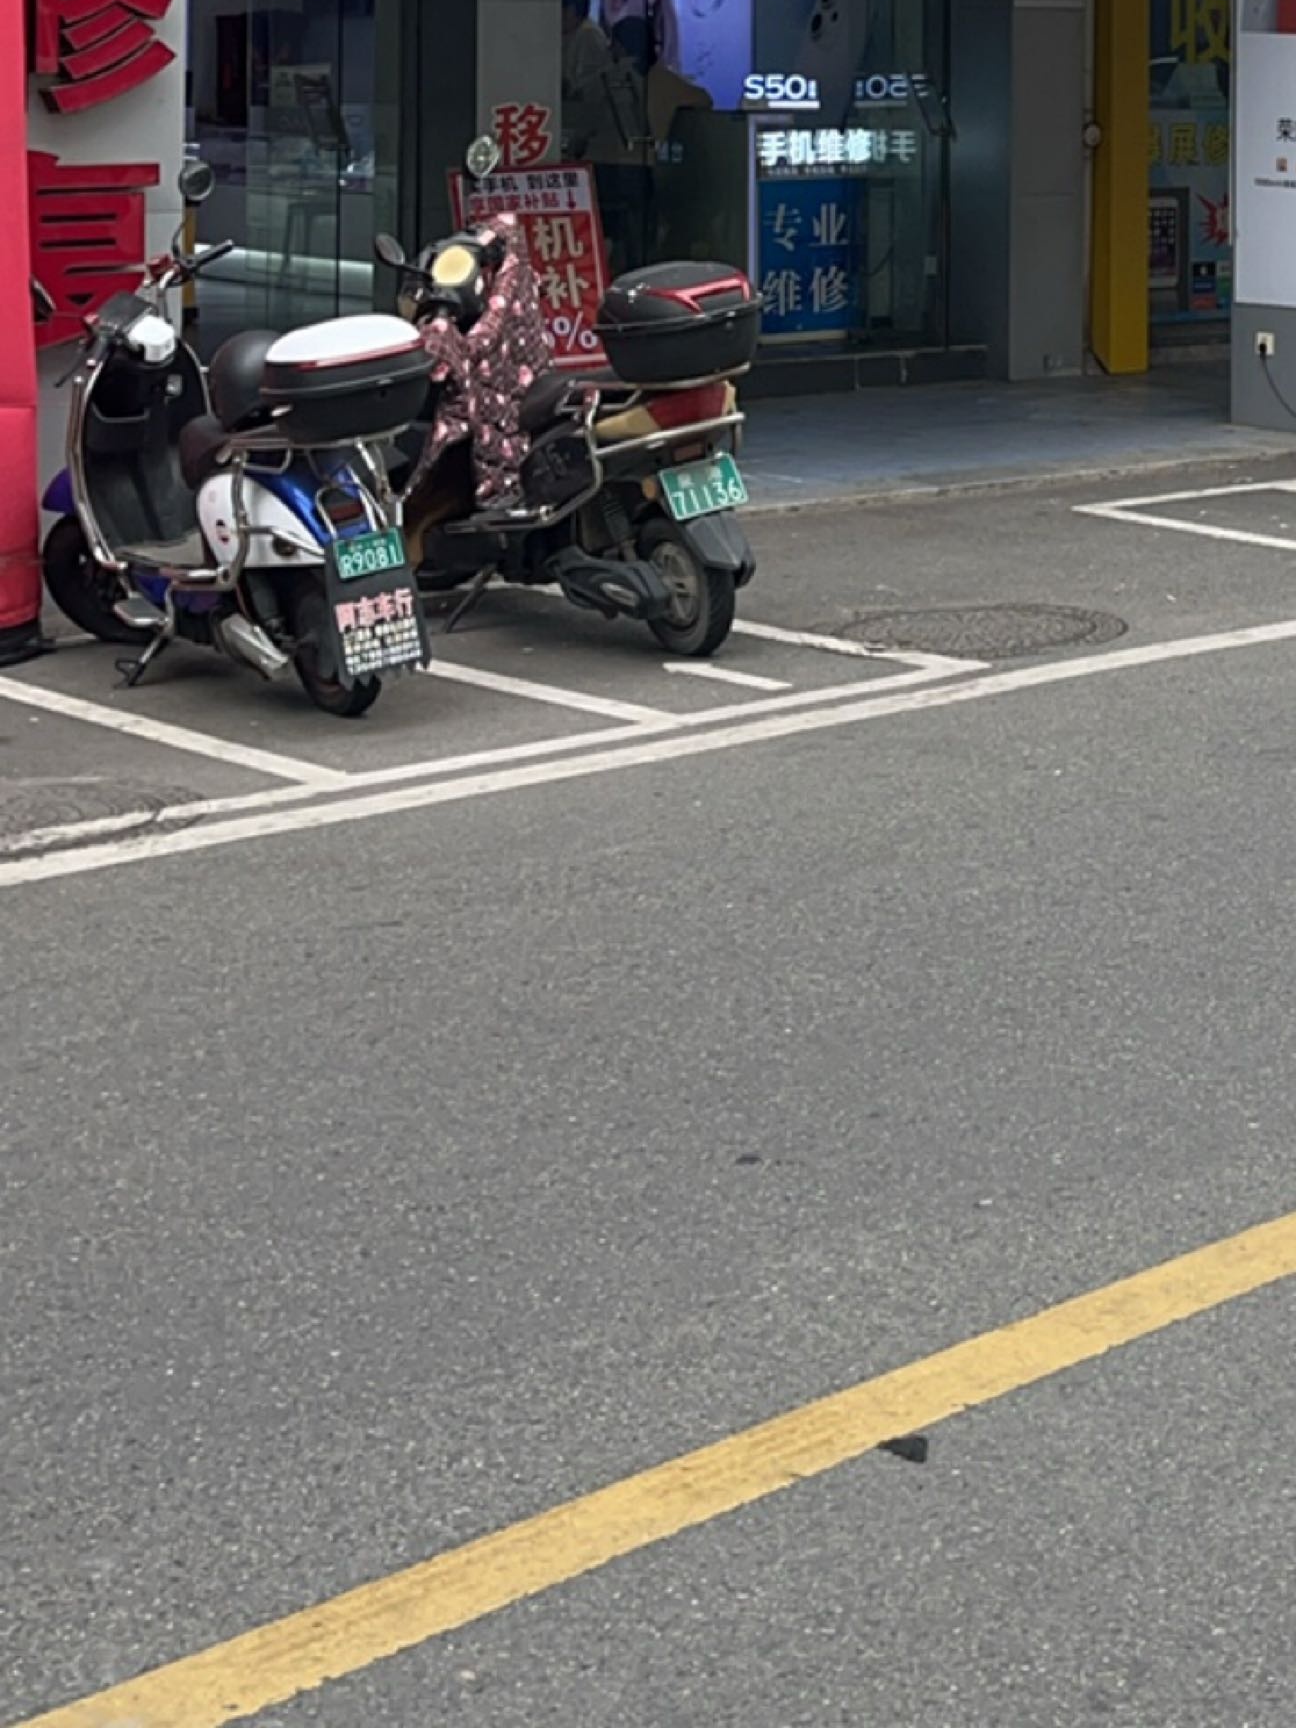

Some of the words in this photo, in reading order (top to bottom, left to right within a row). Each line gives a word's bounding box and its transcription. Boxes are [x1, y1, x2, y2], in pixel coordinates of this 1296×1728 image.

[493, 102, 550, 166] 移
[759, 128, 872, 165] 手机维修
[764, 202, 850, 252] 专业
[762, 264, 850, 317] 维修
